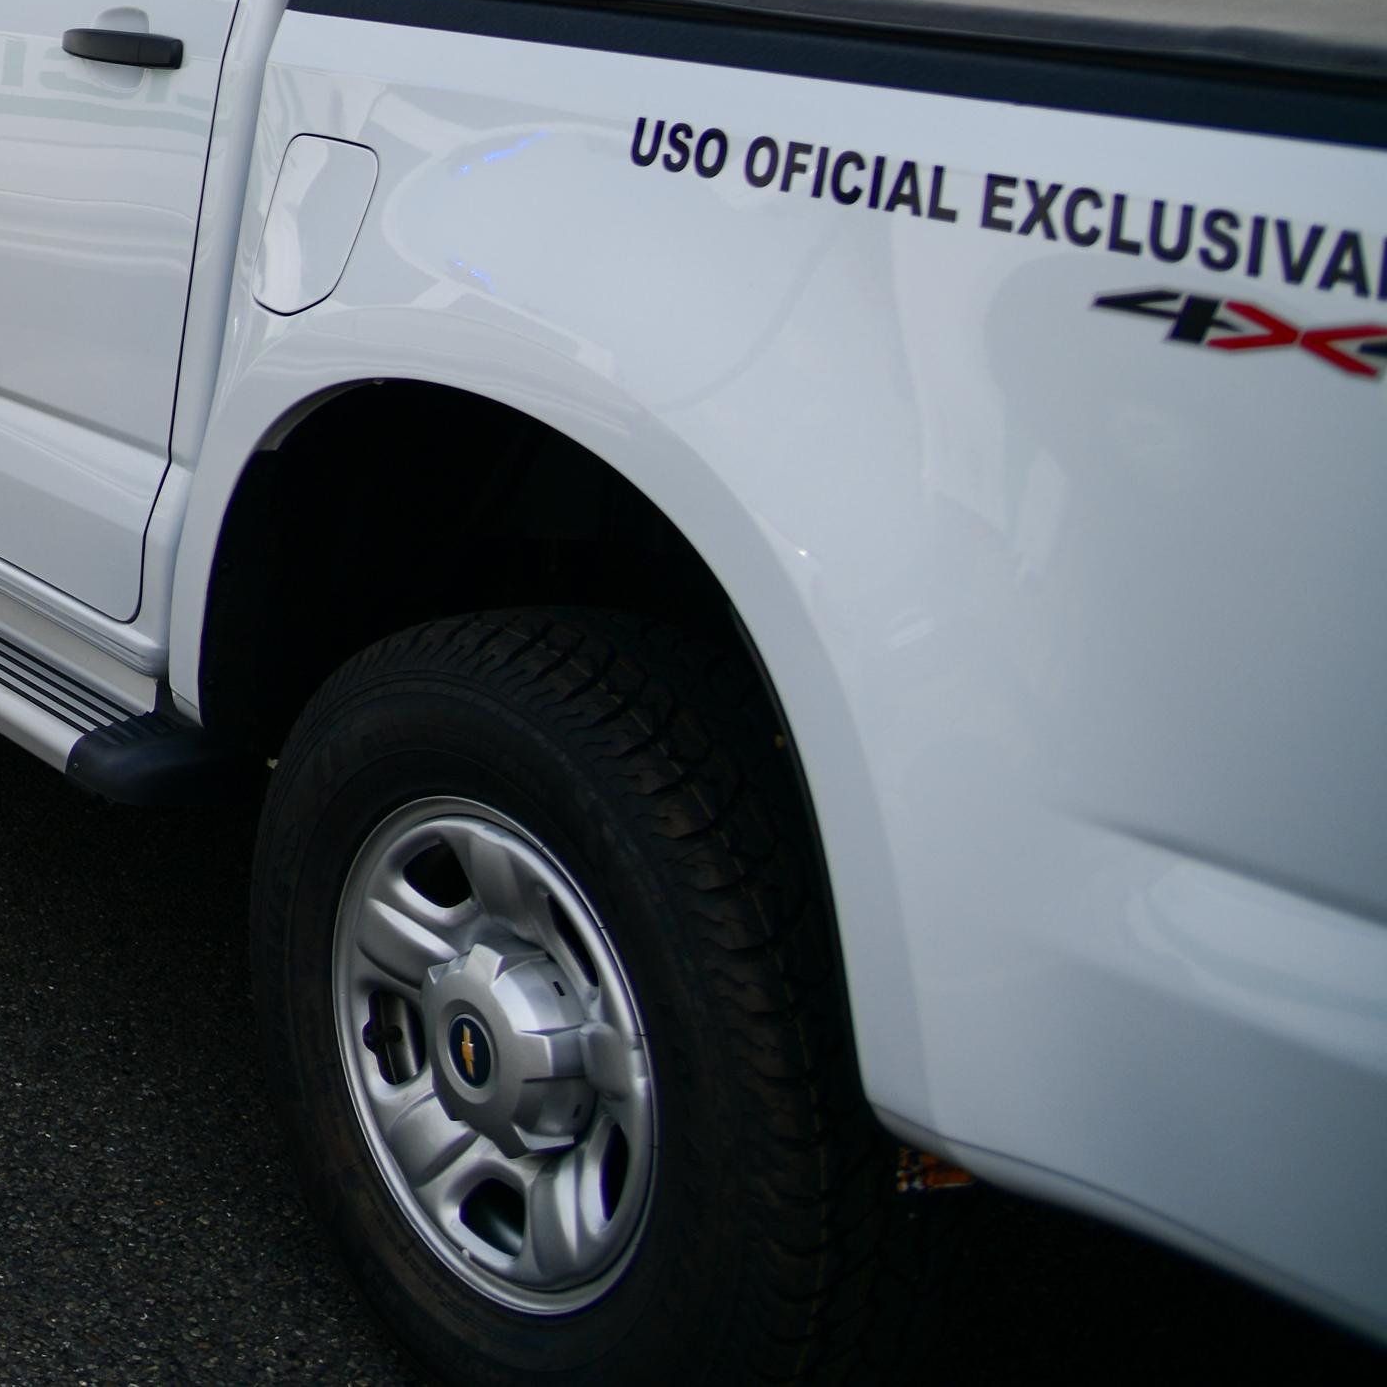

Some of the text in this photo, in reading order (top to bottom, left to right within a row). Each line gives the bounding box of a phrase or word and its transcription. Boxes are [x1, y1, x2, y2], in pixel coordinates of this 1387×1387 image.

[630, 116, 1387, 303] USO OFICIAL EXCLUSIVA
